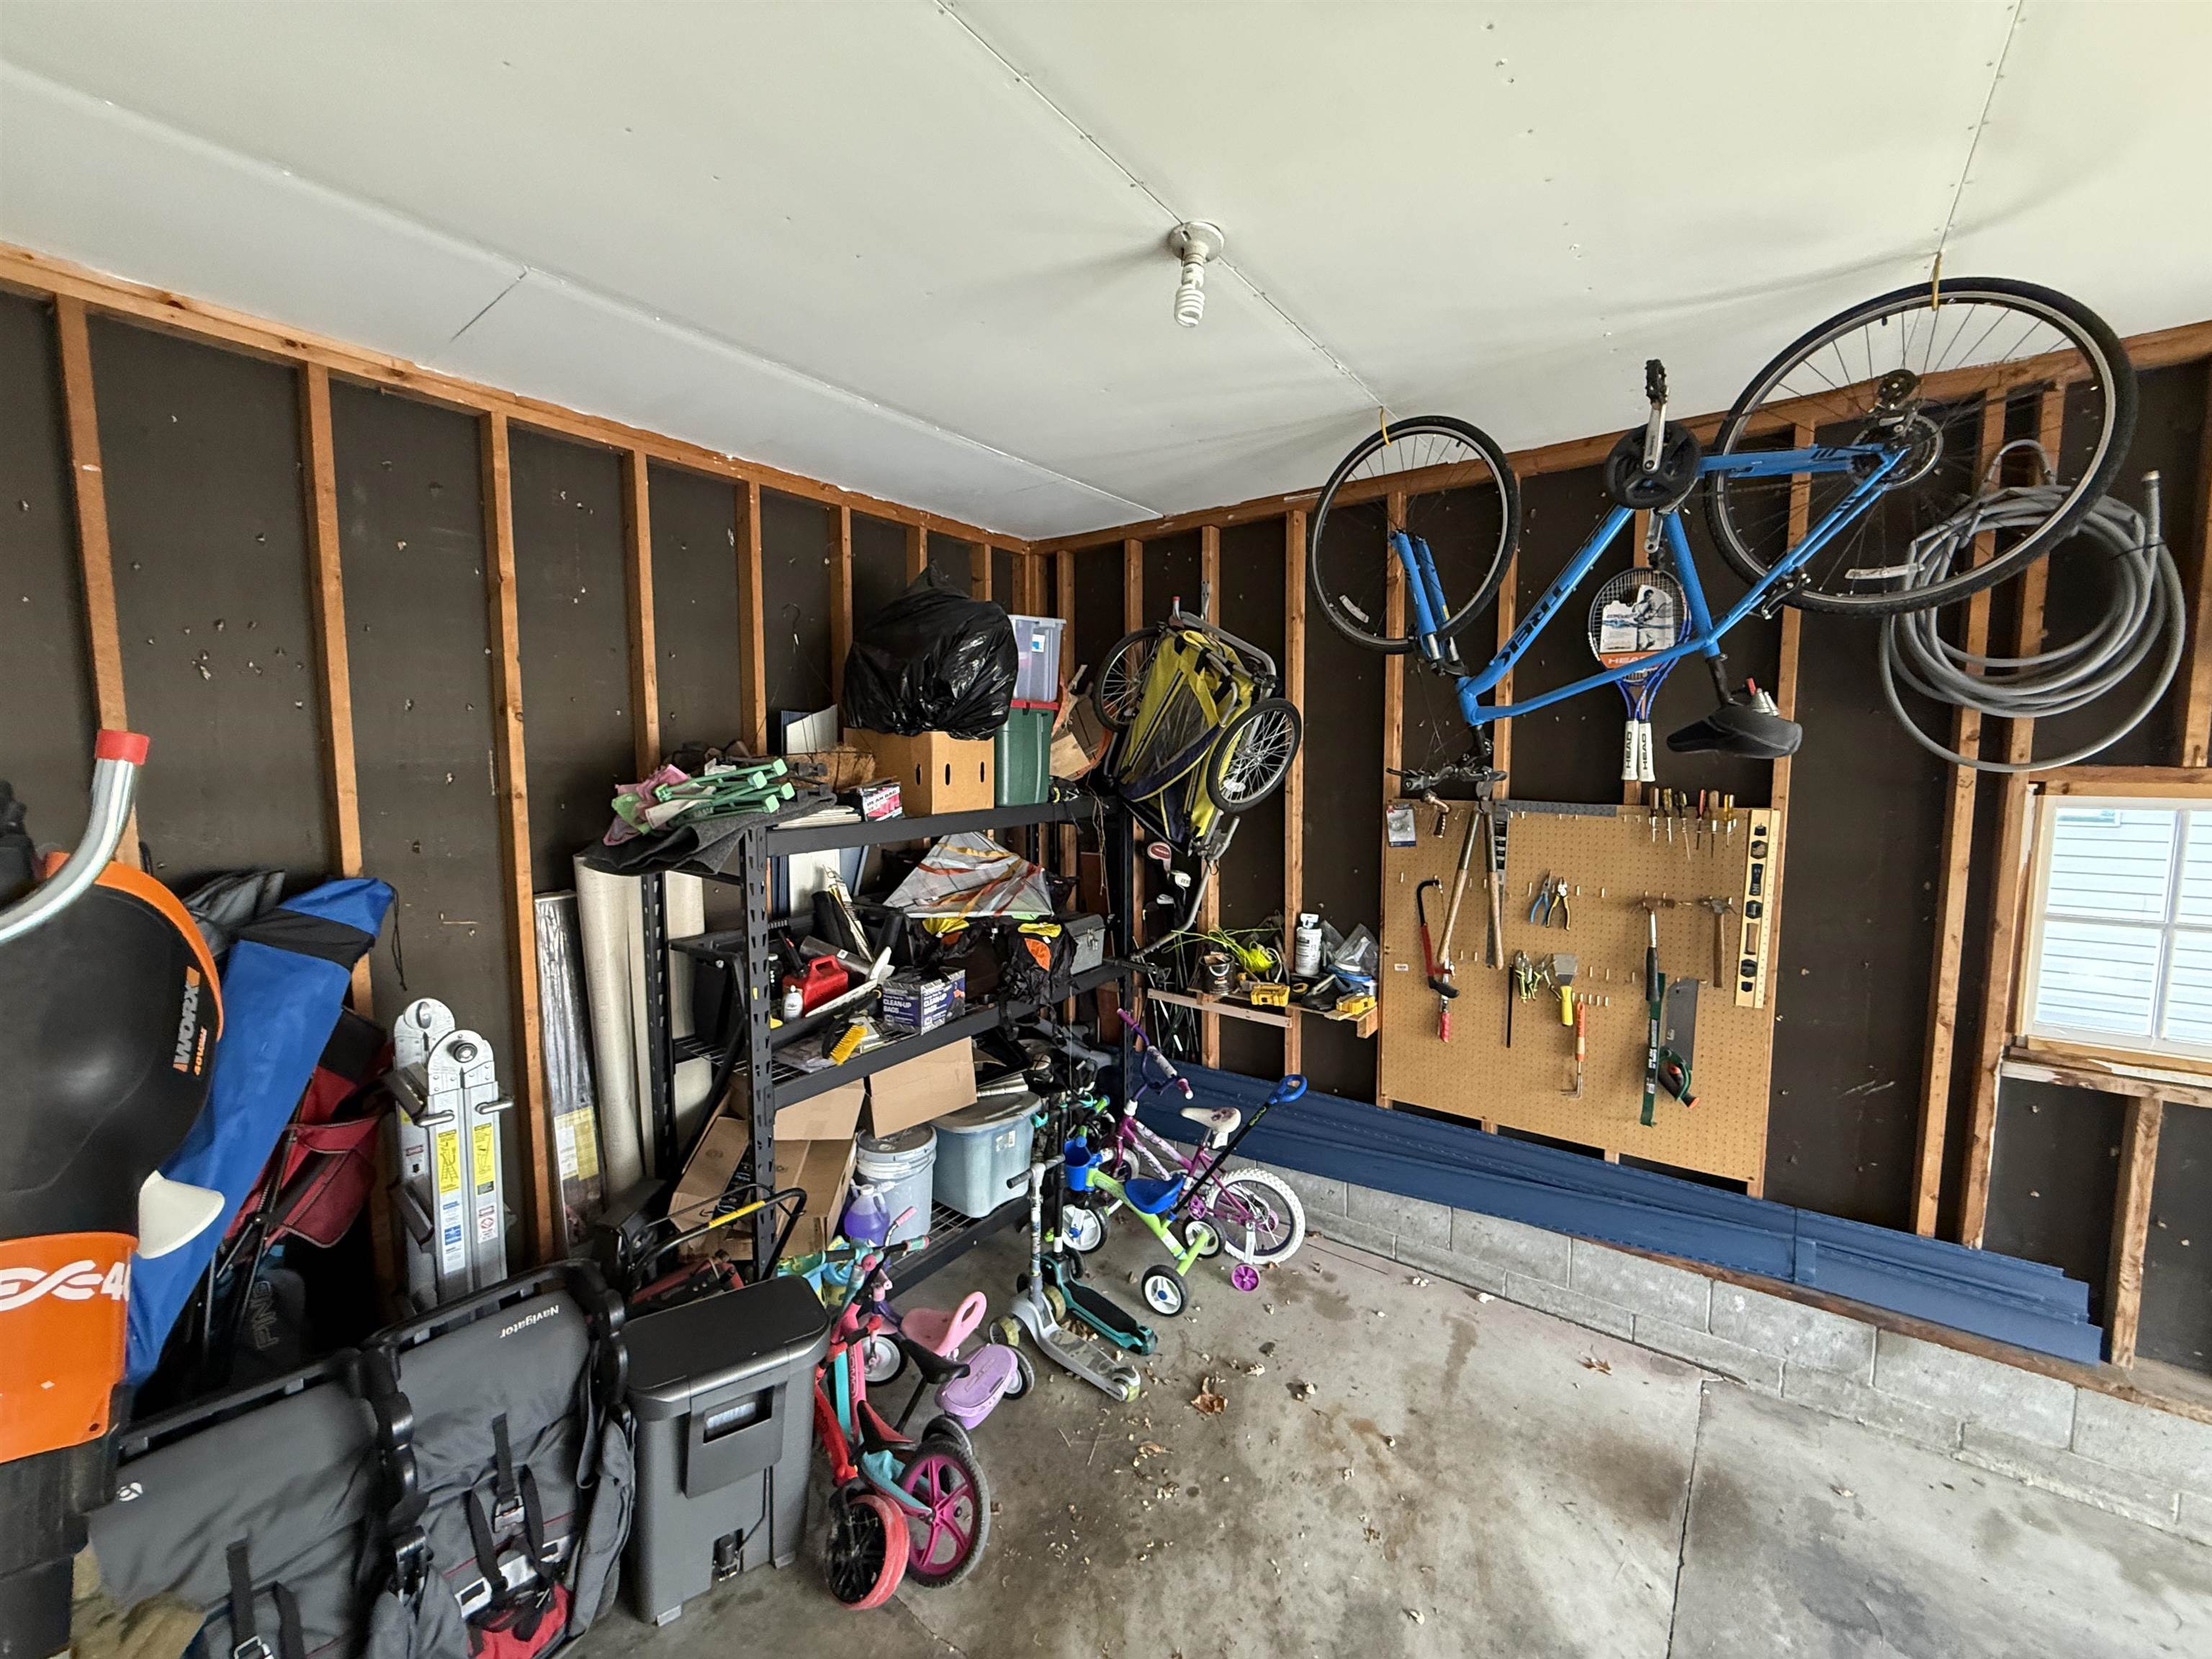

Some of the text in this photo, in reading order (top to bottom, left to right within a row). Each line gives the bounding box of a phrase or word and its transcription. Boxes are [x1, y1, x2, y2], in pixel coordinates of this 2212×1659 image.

[1497, 584, 1570, 667] TREK
[173, 981, 199, 1065] WORX
[883, 998, 912, 1008] CLEAN-UP
[883, 1005, 899, 1014] BAGS
[250, 1280, 279, 1349] PING
[499, 1304, 559, 1339] Navigator
